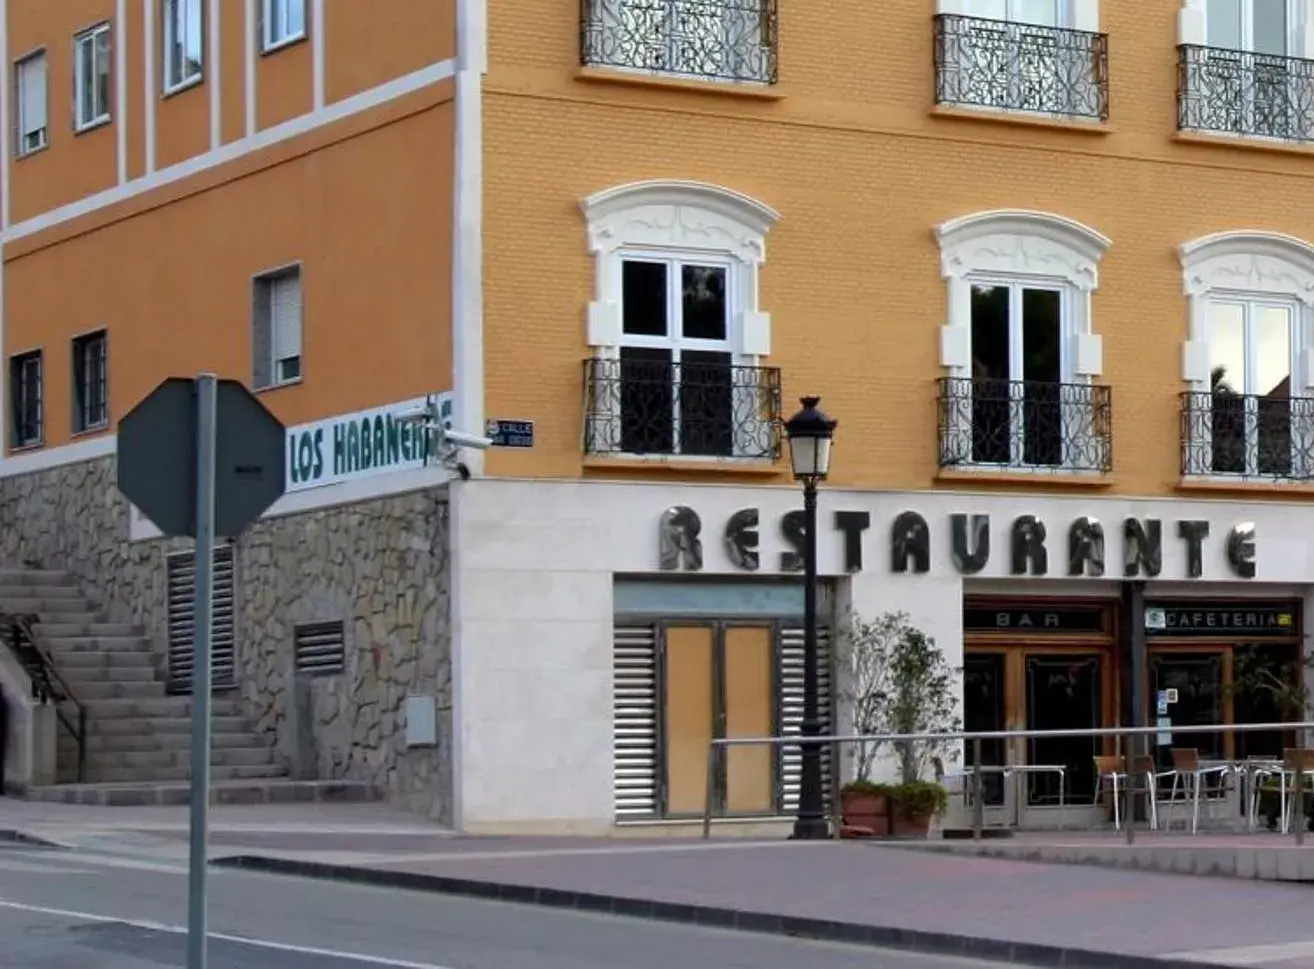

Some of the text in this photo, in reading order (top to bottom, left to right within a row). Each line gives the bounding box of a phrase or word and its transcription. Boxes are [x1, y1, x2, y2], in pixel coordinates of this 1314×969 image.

[290, 429, 323, 483] LOS
[659, 505, 1257, 577] RESTAURANTE
[996, 612, 1060, 627] BAR
[1166, 613, 1278, 627] CAFETERIA
